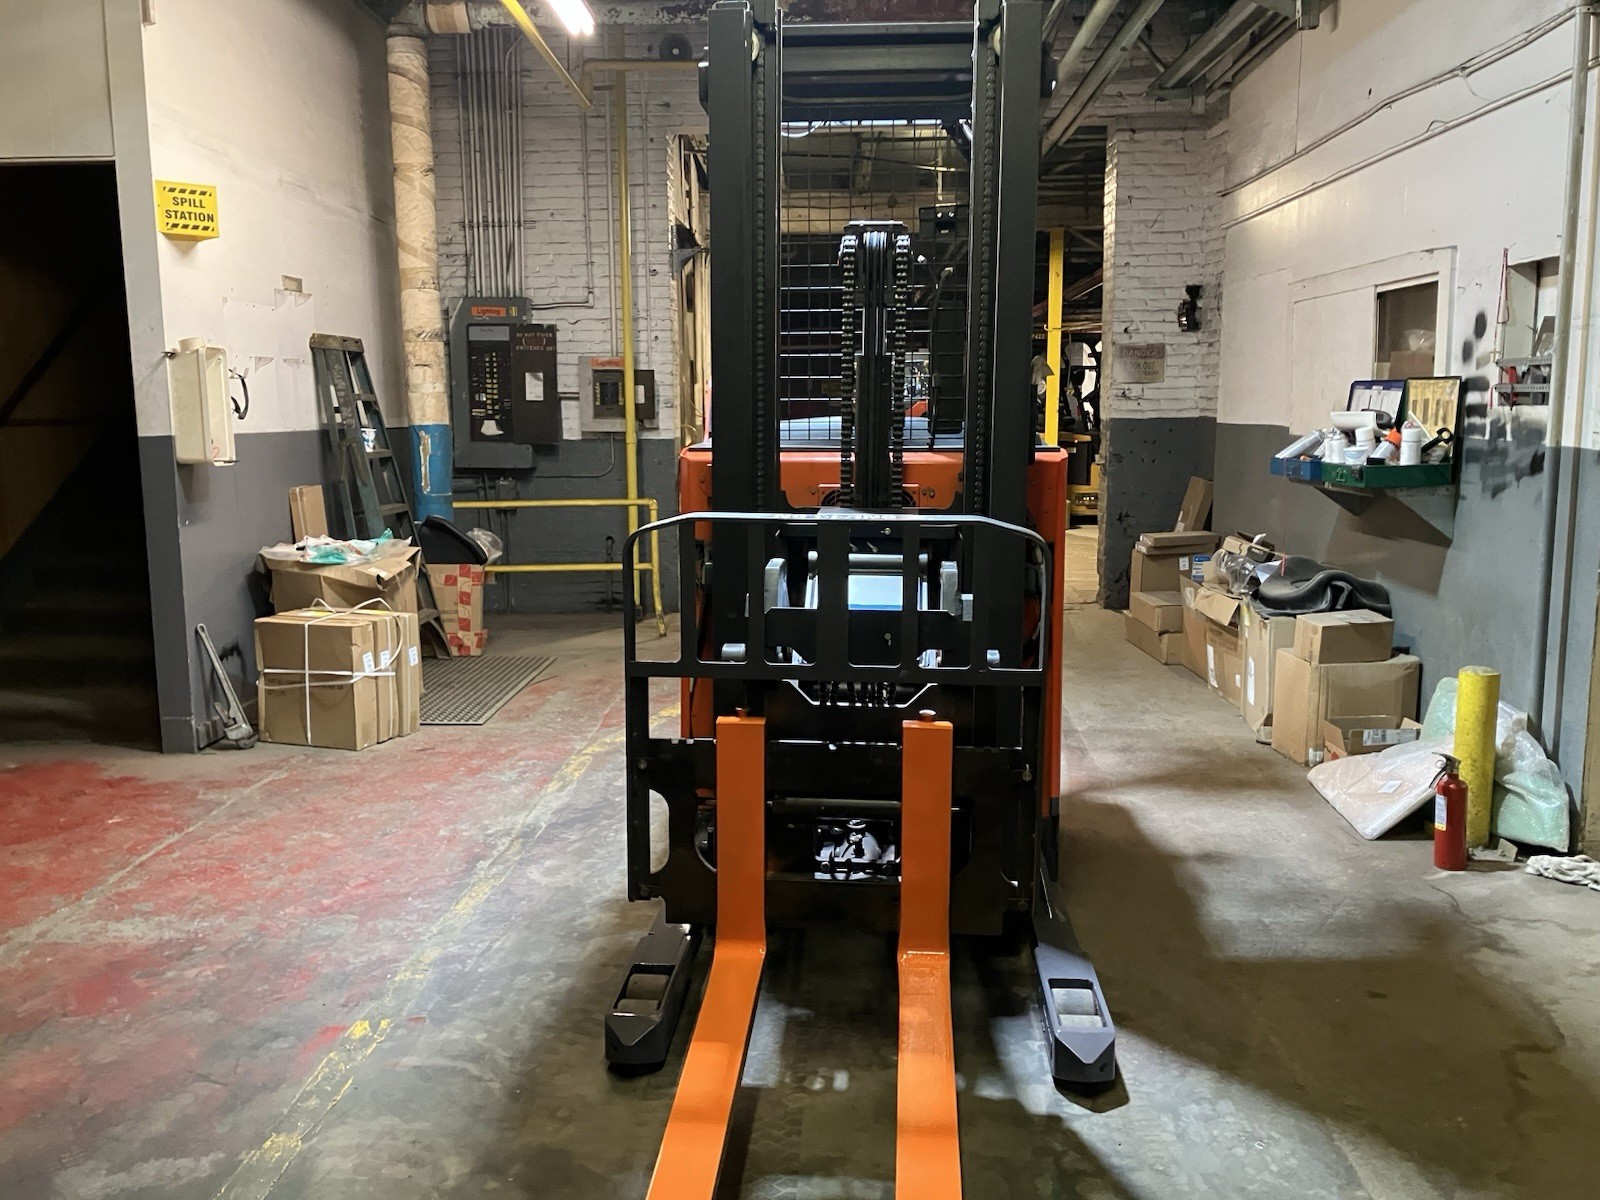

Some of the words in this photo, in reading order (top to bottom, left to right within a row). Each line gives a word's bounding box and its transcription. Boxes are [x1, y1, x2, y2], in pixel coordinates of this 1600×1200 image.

[172, 196, 206, 209] SPILL
[165, 209, 214, 223] STATION
[476, 307, 501, 316] Lighting
